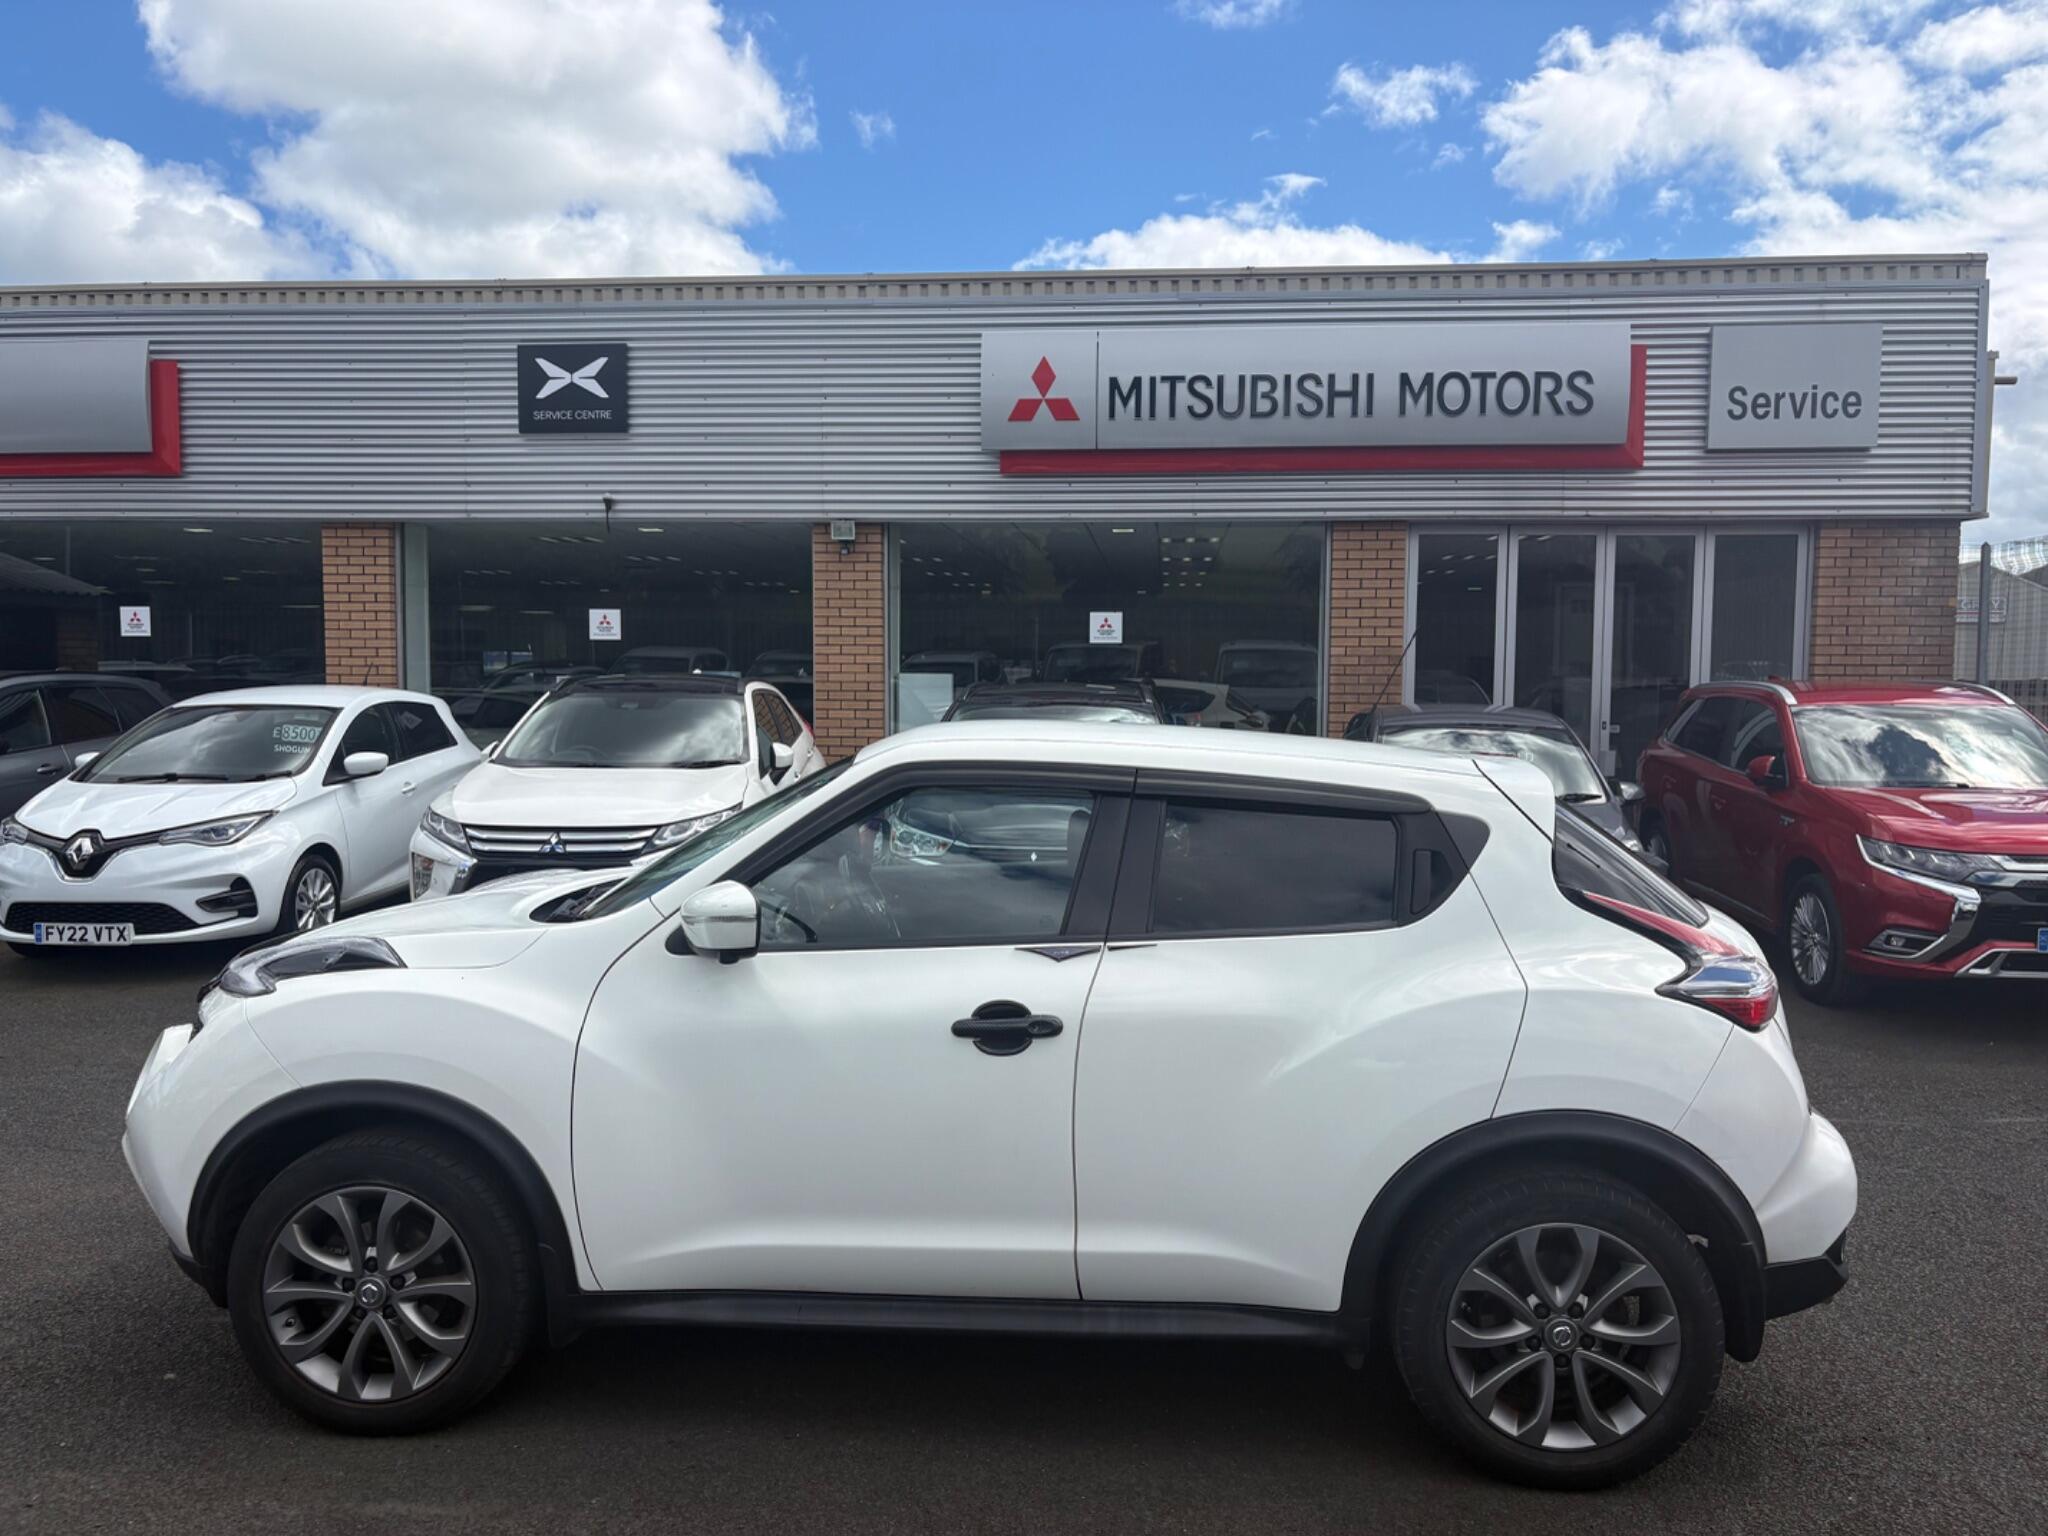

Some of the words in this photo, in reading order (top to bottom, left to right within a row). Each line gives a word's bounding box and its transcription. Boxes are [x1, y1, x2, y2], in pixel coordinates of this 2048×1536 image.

[1107, 373, 1375, 421] MITSUBISHI
[1400, 370, 1595, 418] MOTORS
[1727, 384, 1862, 421] Service
[533, 410, 573, 420] SERVICE
[574, 409, 613, 420] CENTRE
[45, 925, 88, 942] FY22
[93, 925, 127, 942] VTX
